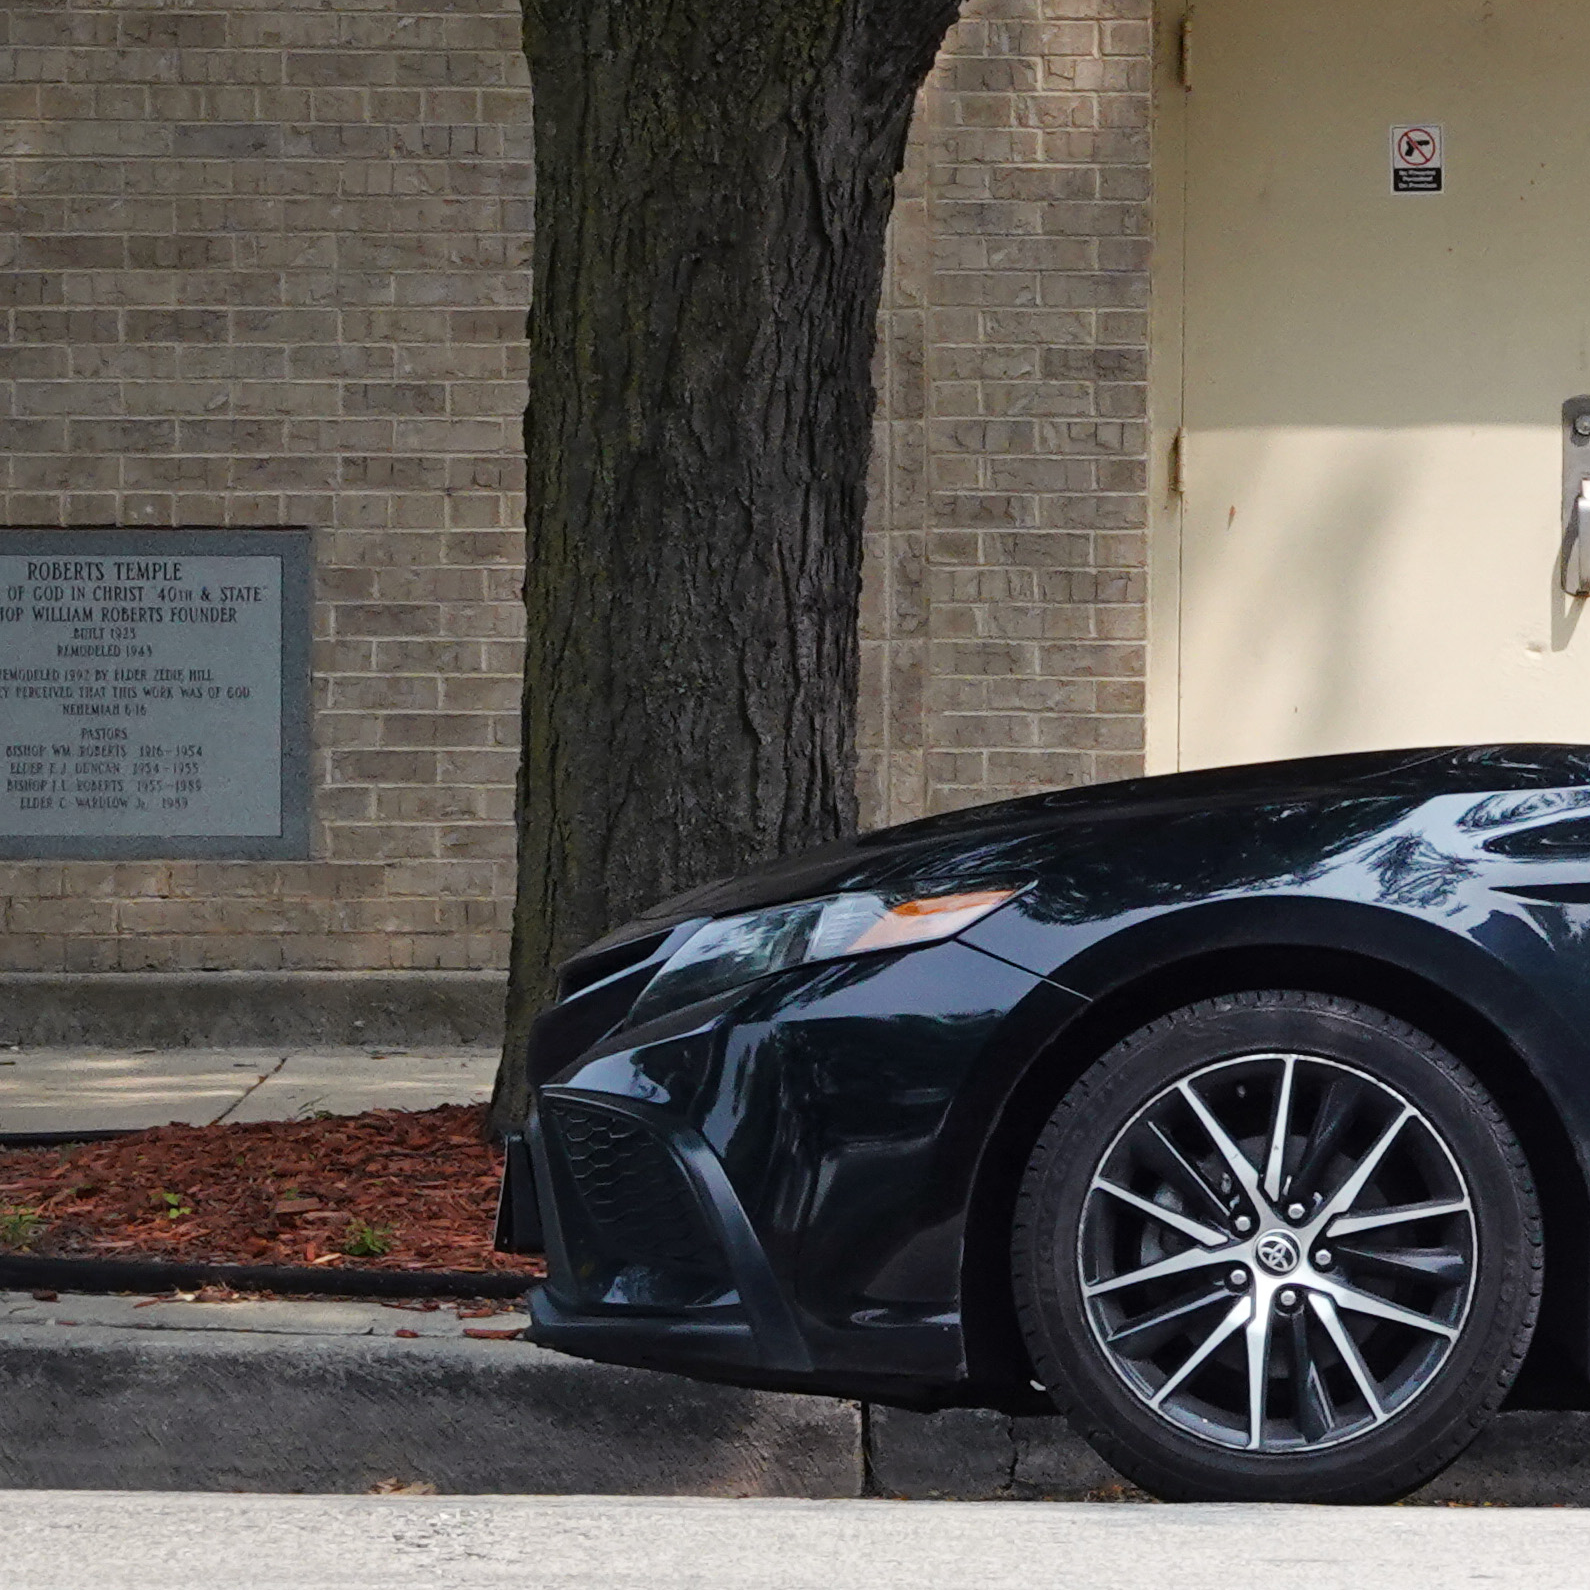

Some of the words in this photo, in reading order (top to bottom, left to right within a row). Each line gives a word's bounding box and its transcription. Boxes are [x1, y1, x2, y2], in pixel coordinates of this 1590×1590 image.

[27, 561, 105, 581] ROBERTS
[113, 561, 183, 581] TEMPLE
[7, 586, 25, 602] OF
[33, 586, 64, 602] GOD
[71, 586, 86, 602] IN
[93, 586, 145, 602] CHRIST
[201, 586, 212, 602] &
[32, 607, 93, 623] WILLIAM
[101, 607, 163, 623] ROBERTS
[170, 607, 238, 623] FOUNDER
[57, 644, 121, 658] REMODELED
[115, 668, 147, 682] ELDER
